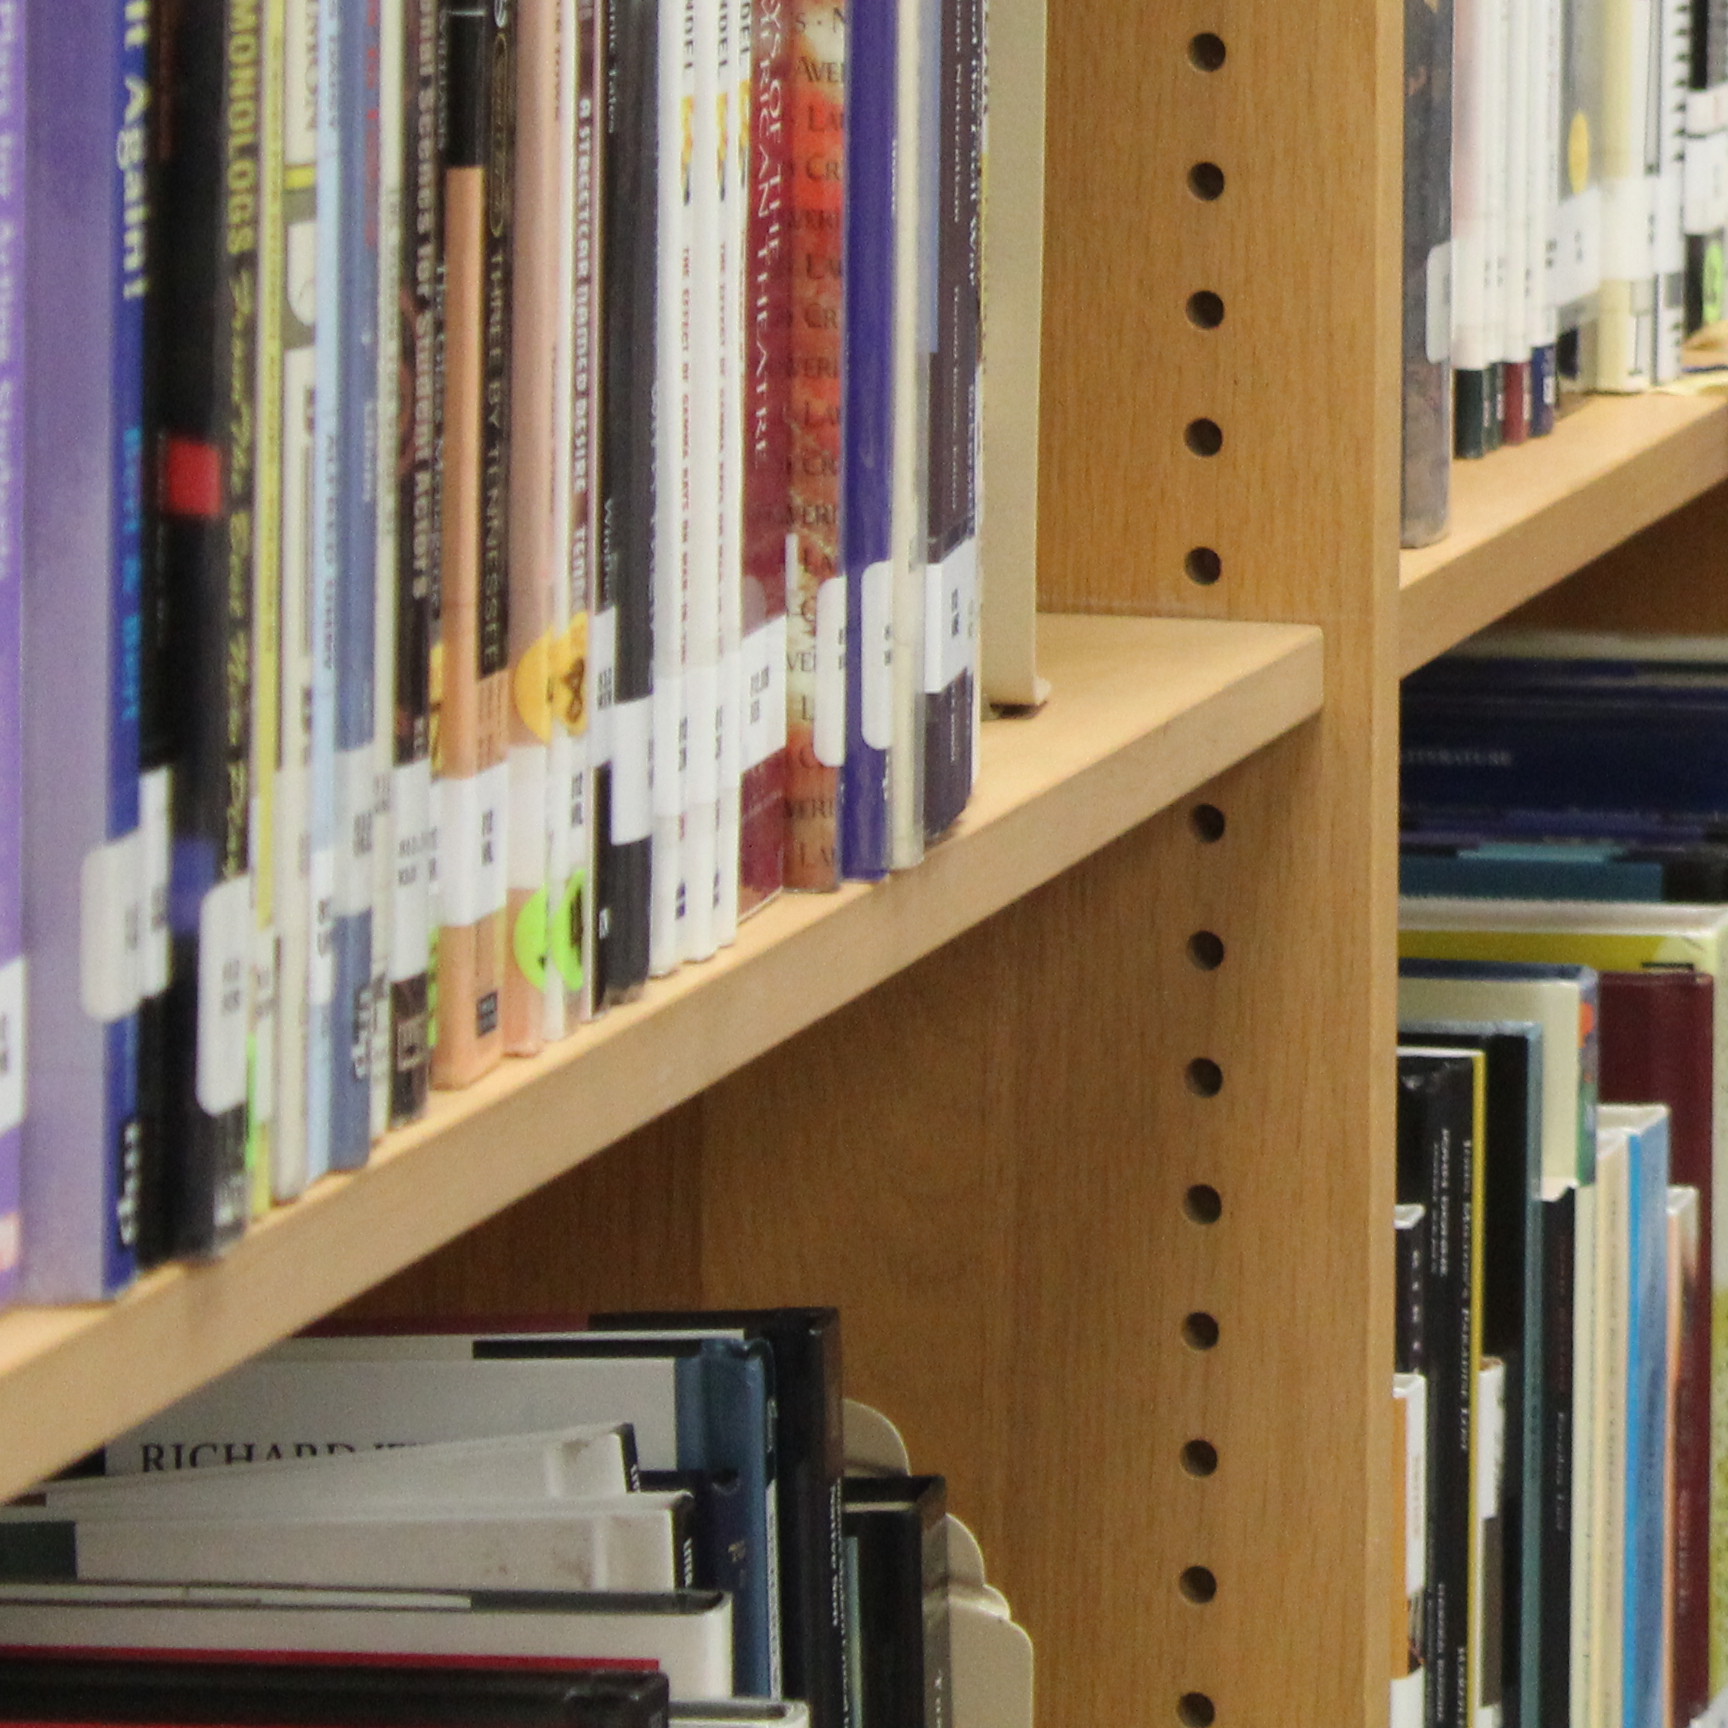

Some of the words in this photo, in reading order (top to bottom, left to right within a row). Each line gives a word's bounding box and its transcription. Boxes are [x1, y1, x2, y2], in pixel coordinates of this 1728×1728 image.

[325, 34, 338, 129] DAISY
[606, 69, 619, 134] Tales
[766, 78, 782, 145] OF
[116, 78, 153, 302] Again!
[416, 86, 435, 235] Scenes
[574, 125, 591, 276] STREETCAR
[764, 162, 782, 260] THE
[415, 243, 434, 298] for
[488, 247, 505, 364] THREE
[413, 310, 434, 464] Student
[573, 284, 590, 392] NAMED
[754, 240, 770, 469] THEATRE
[487, 377, 503, 435] BY
[572, 398, 589, 494] DESIRE
[411, 471, 433, 599] Actors
[483, 445, 502, 669] TENNESSEE
